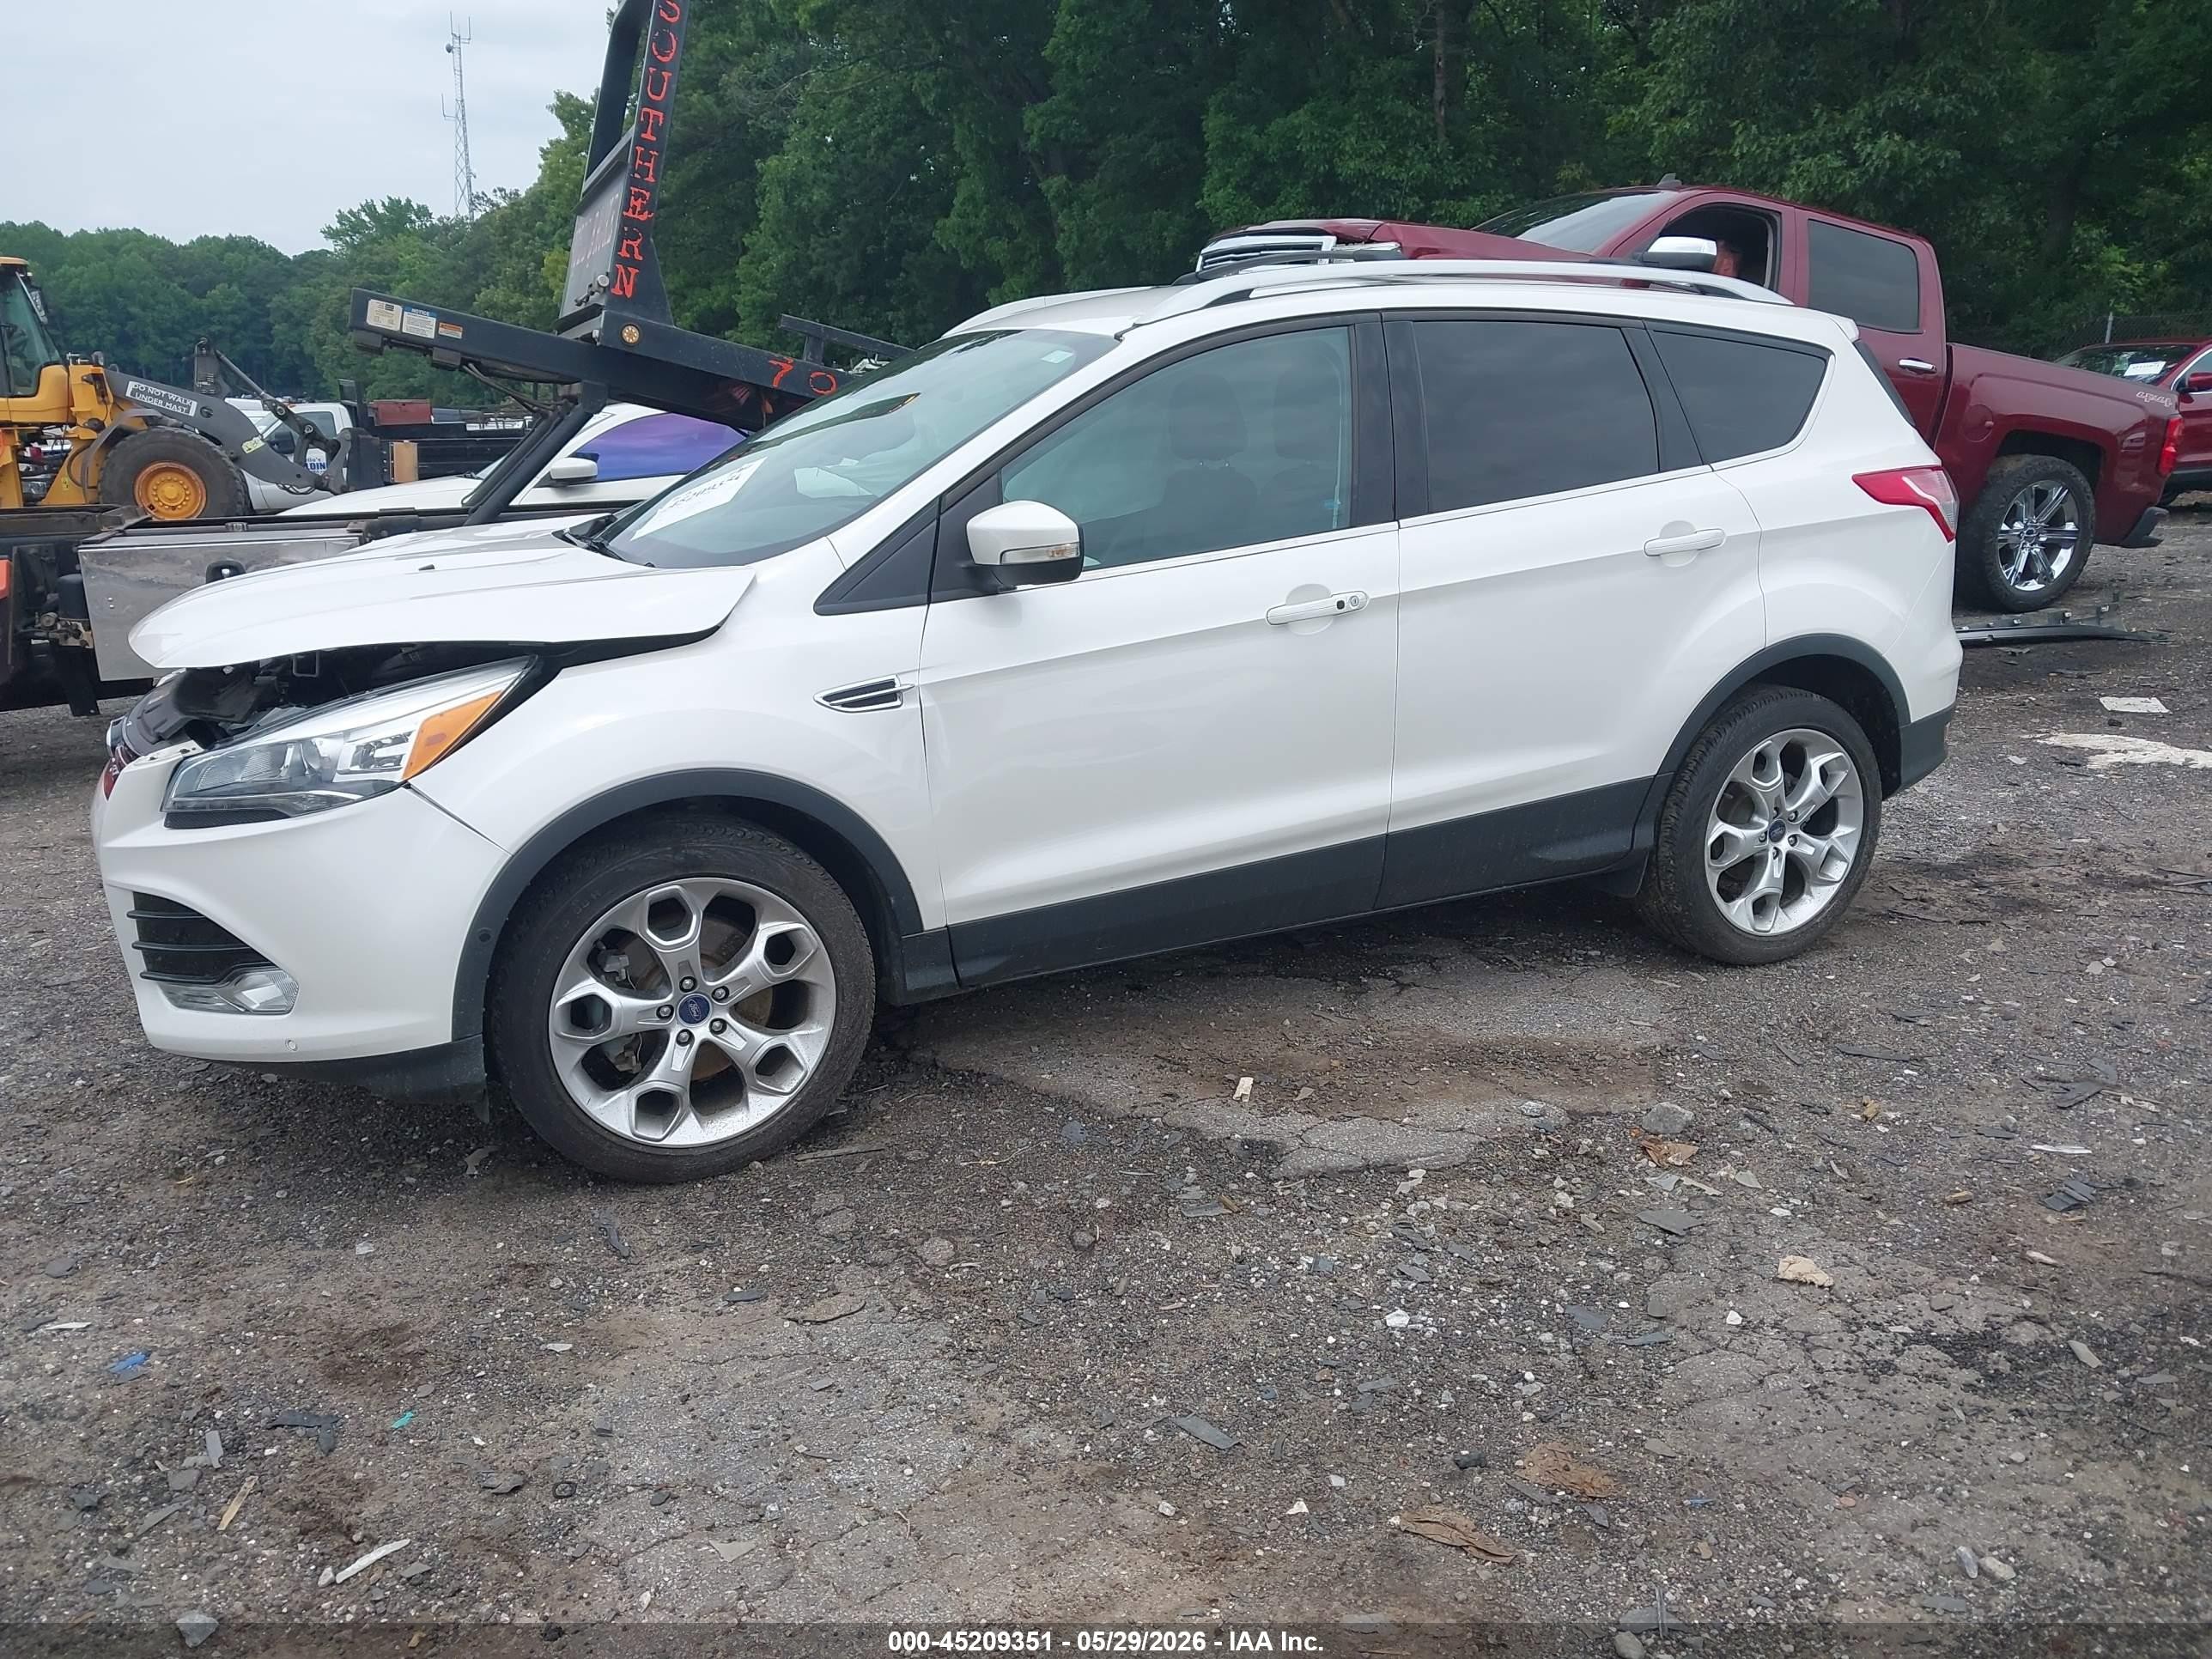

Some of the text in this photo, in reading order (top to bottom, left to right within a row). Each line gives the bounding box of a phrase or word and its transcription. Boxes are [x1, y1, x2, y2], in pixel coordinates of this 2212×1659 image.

[131, 383, 192, 406] DO NOT WALK
[135, 392, 188, 414] UNDER MAST
